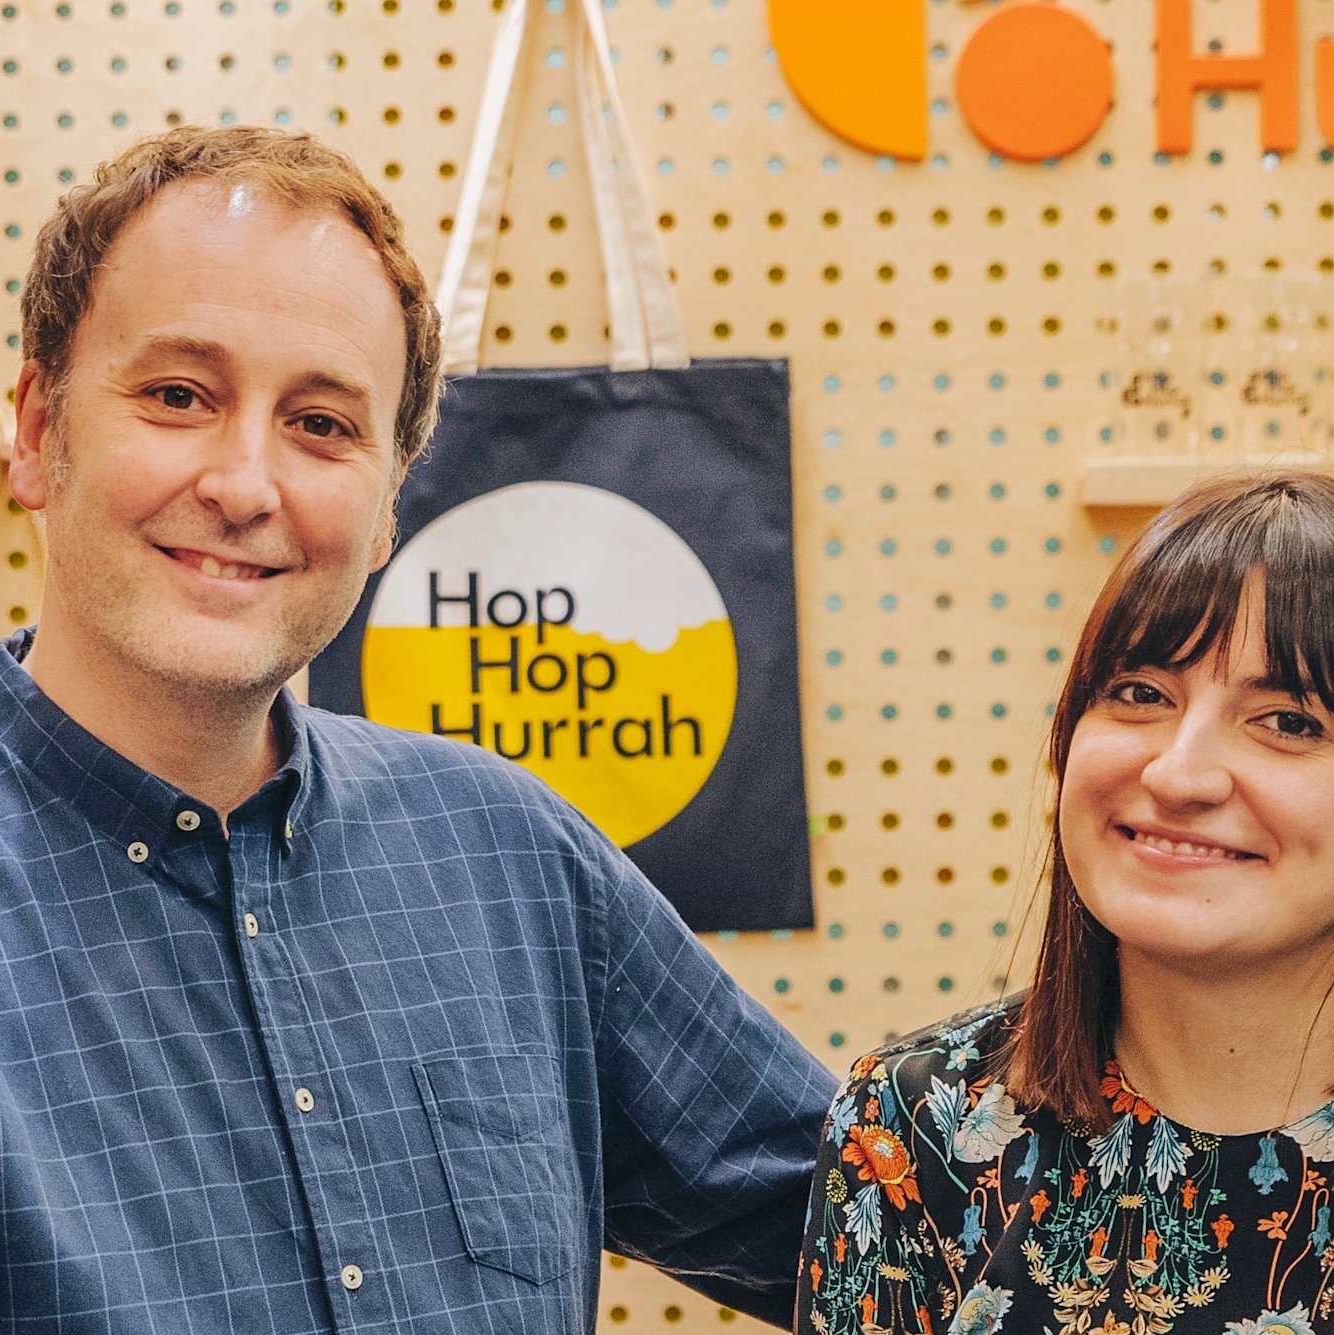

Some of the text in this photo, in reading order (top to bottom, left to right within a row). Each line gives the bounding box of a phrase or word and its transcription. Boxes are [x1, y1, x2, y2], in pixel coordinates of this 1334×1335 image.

[429, 570, 576, 645] Hop
[469, 635, 617, 709] Hop
[430, 693, 703, 761] Hurrah
